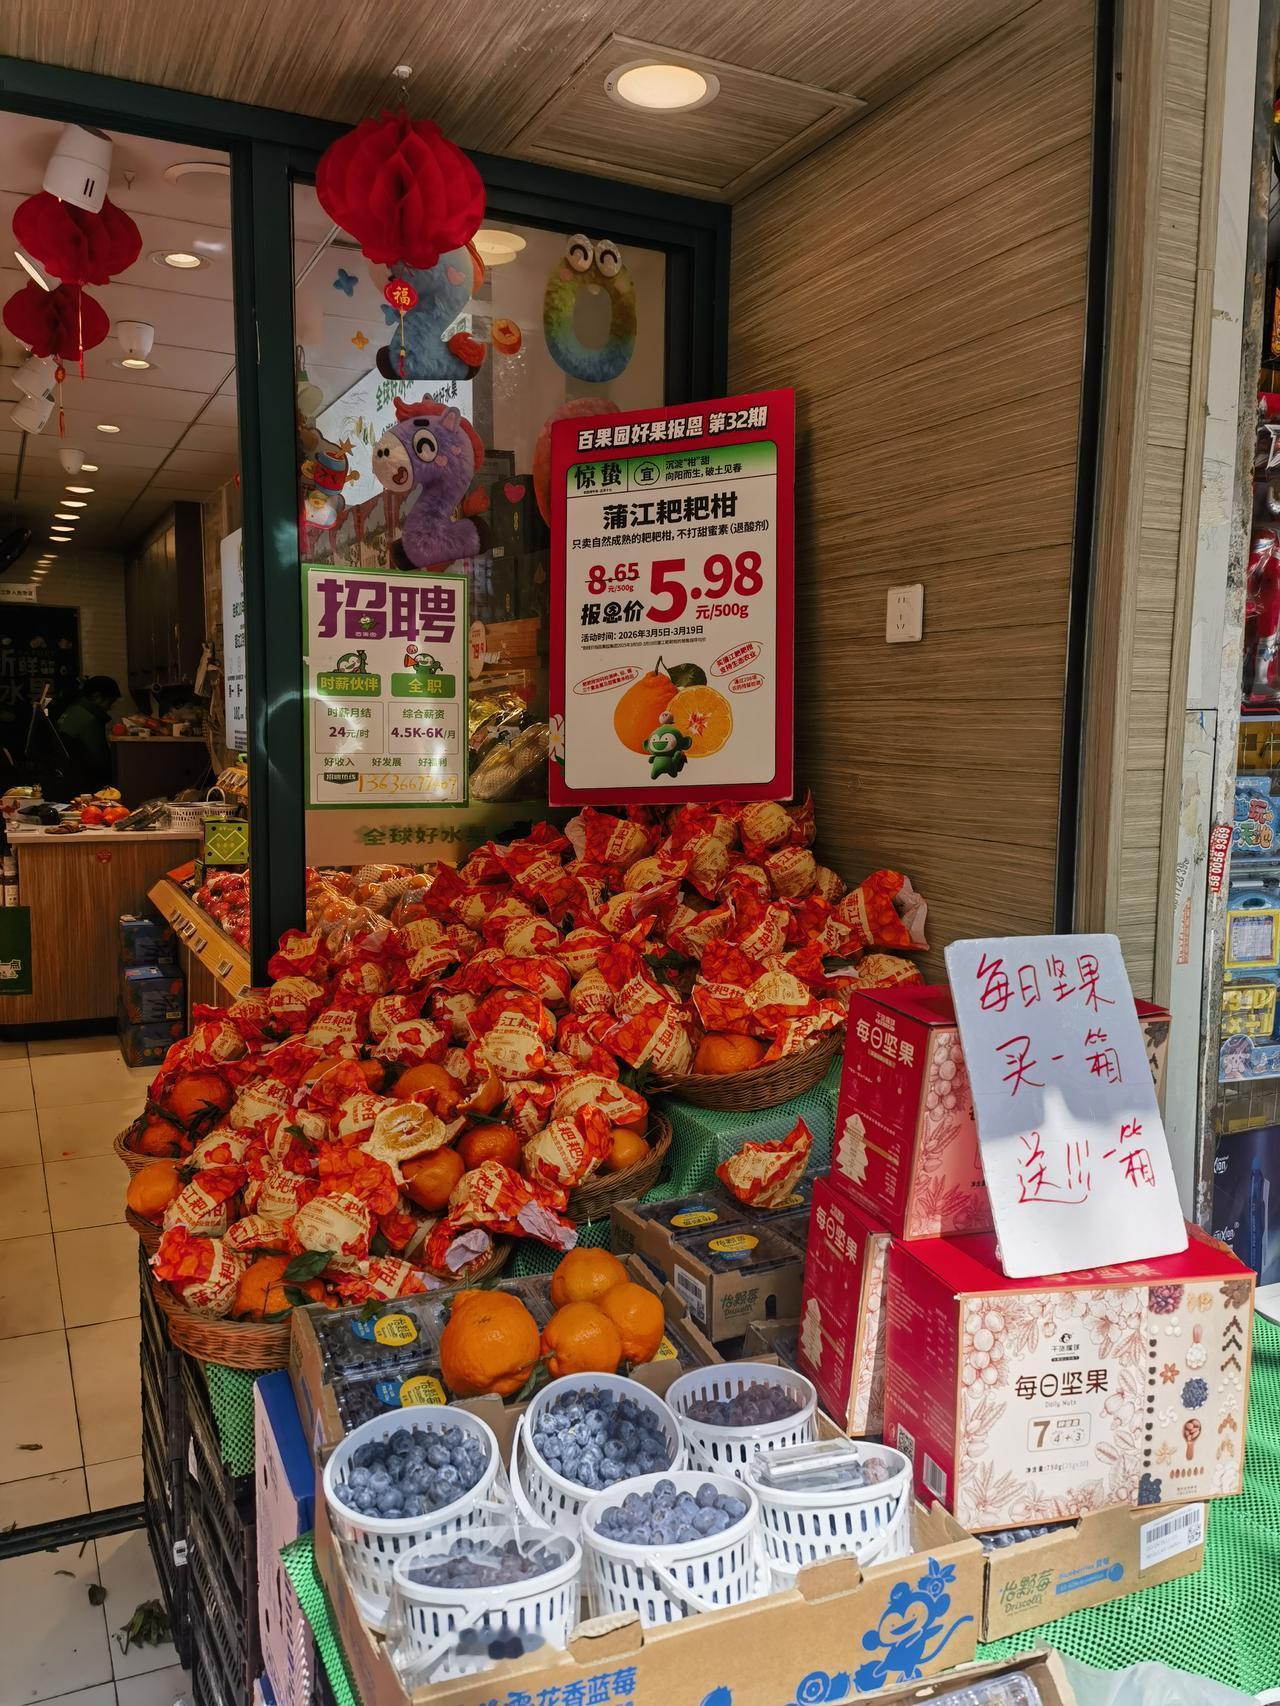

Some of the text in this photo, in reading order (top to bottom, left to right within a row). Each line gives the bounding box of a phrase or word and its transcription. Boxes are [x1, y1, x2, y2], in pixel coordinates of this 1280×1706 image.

[577, 405, 769, 452] 百果园好果报恩 第32期
[574, 461, 623, 490] 惊蛰
[640, 466, 655, 482] 宜
[602, 491, 738, 531] 蒲江耙耙柑
[587, 562, 640, 596] 8.65
[645, 550, 764, 623] 5.98
[317, 577, 456, 644] 招聘
[580, 599, 645, 626] 报恩价
[695, 602, 750, 621] 元/500g
[320, 676, 379, 692] 时薪伙伴
[407, 678, 443, 694] 全职
[327, 707, 372, 719] 时薪月结
[402, 708, 445, 720] 综合薪资
[328, 725, 370, 740] 24元/时
[390, 726, 457, 740] 4.5K-6K/月
[323, 757, 355, 767] 好收入
[371, 757, 402, 767] 好发展
[417, 757, 448, 767] 好福利
[363, 826, 478, 847] 全球好水
[976, 952, 1116, 1013] 每日坚果
[856, 1017, 915, 1068] 每日坚果
[995, 1027, 1123, 1097] 买一箱
[815, 1205, 858, 1265] 每日坚果
[1014, 1368, 1109, 1400] 每日坚果
[1032, 1420, 1051, 1449] 7
